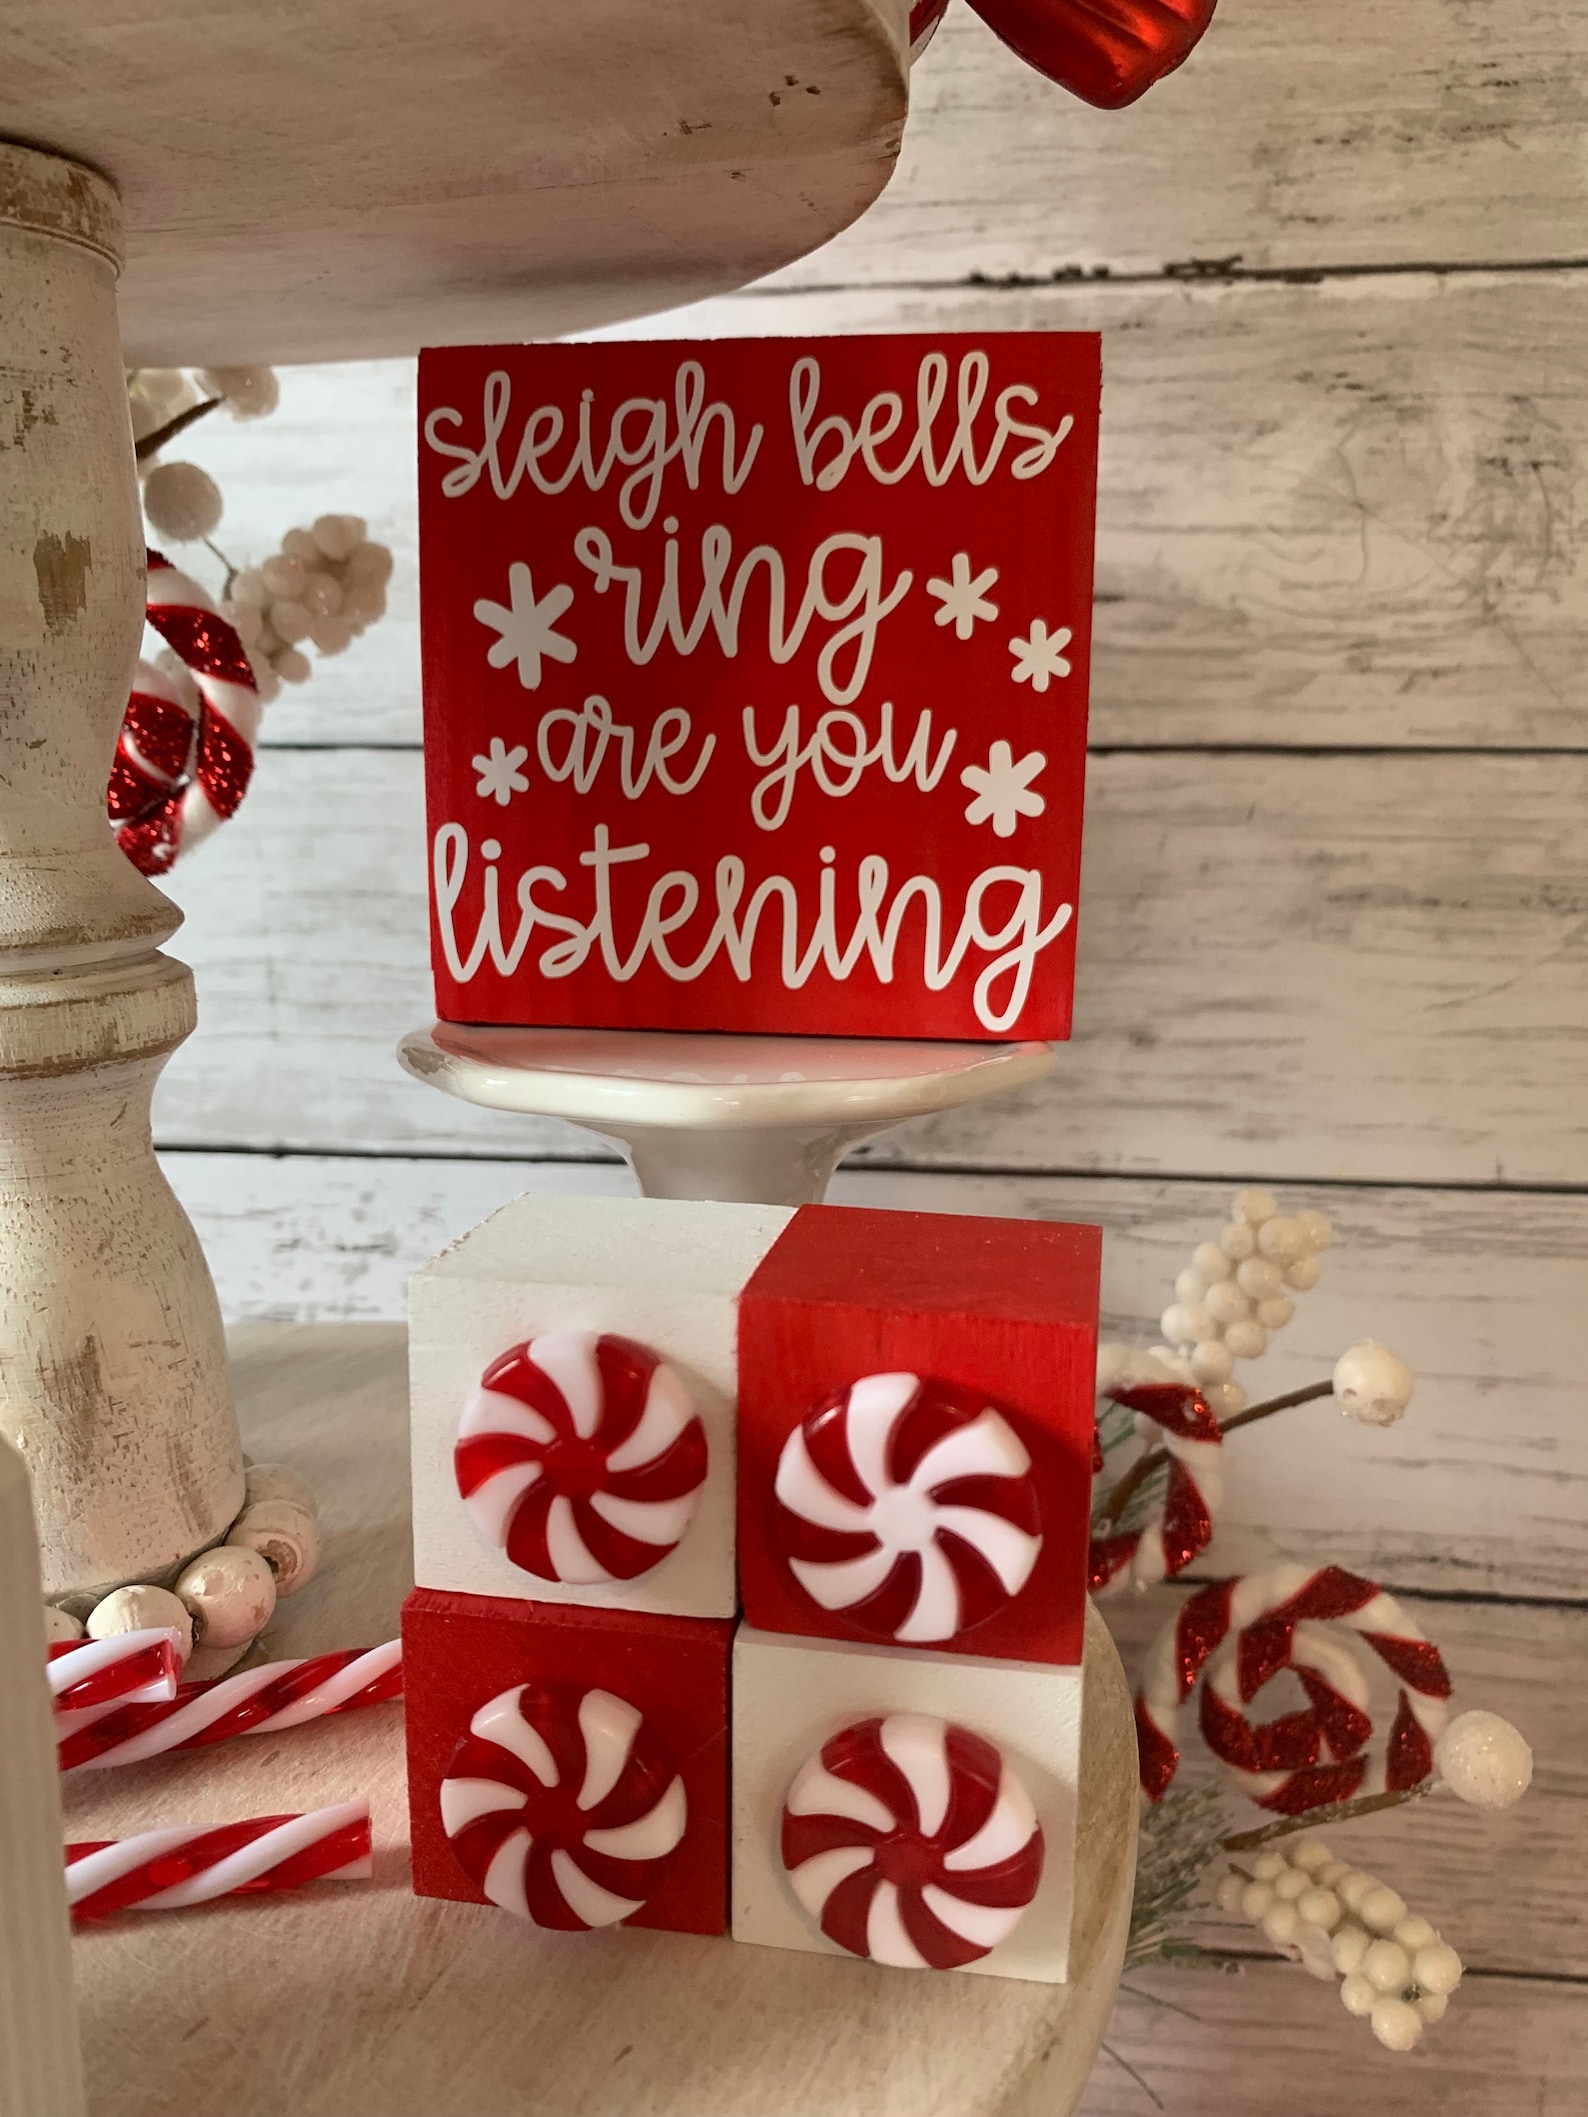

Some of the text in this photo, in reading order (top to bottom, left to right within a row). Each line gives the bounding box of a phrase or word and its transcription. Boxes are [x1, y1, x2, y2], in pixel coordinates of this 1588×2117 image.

[424, 351, 1074, 530] sleigh bells
[573, 516, 913, 706] ring
[537, 694, 957, 831] are you
[433, 822, 1073, 1033] listening
